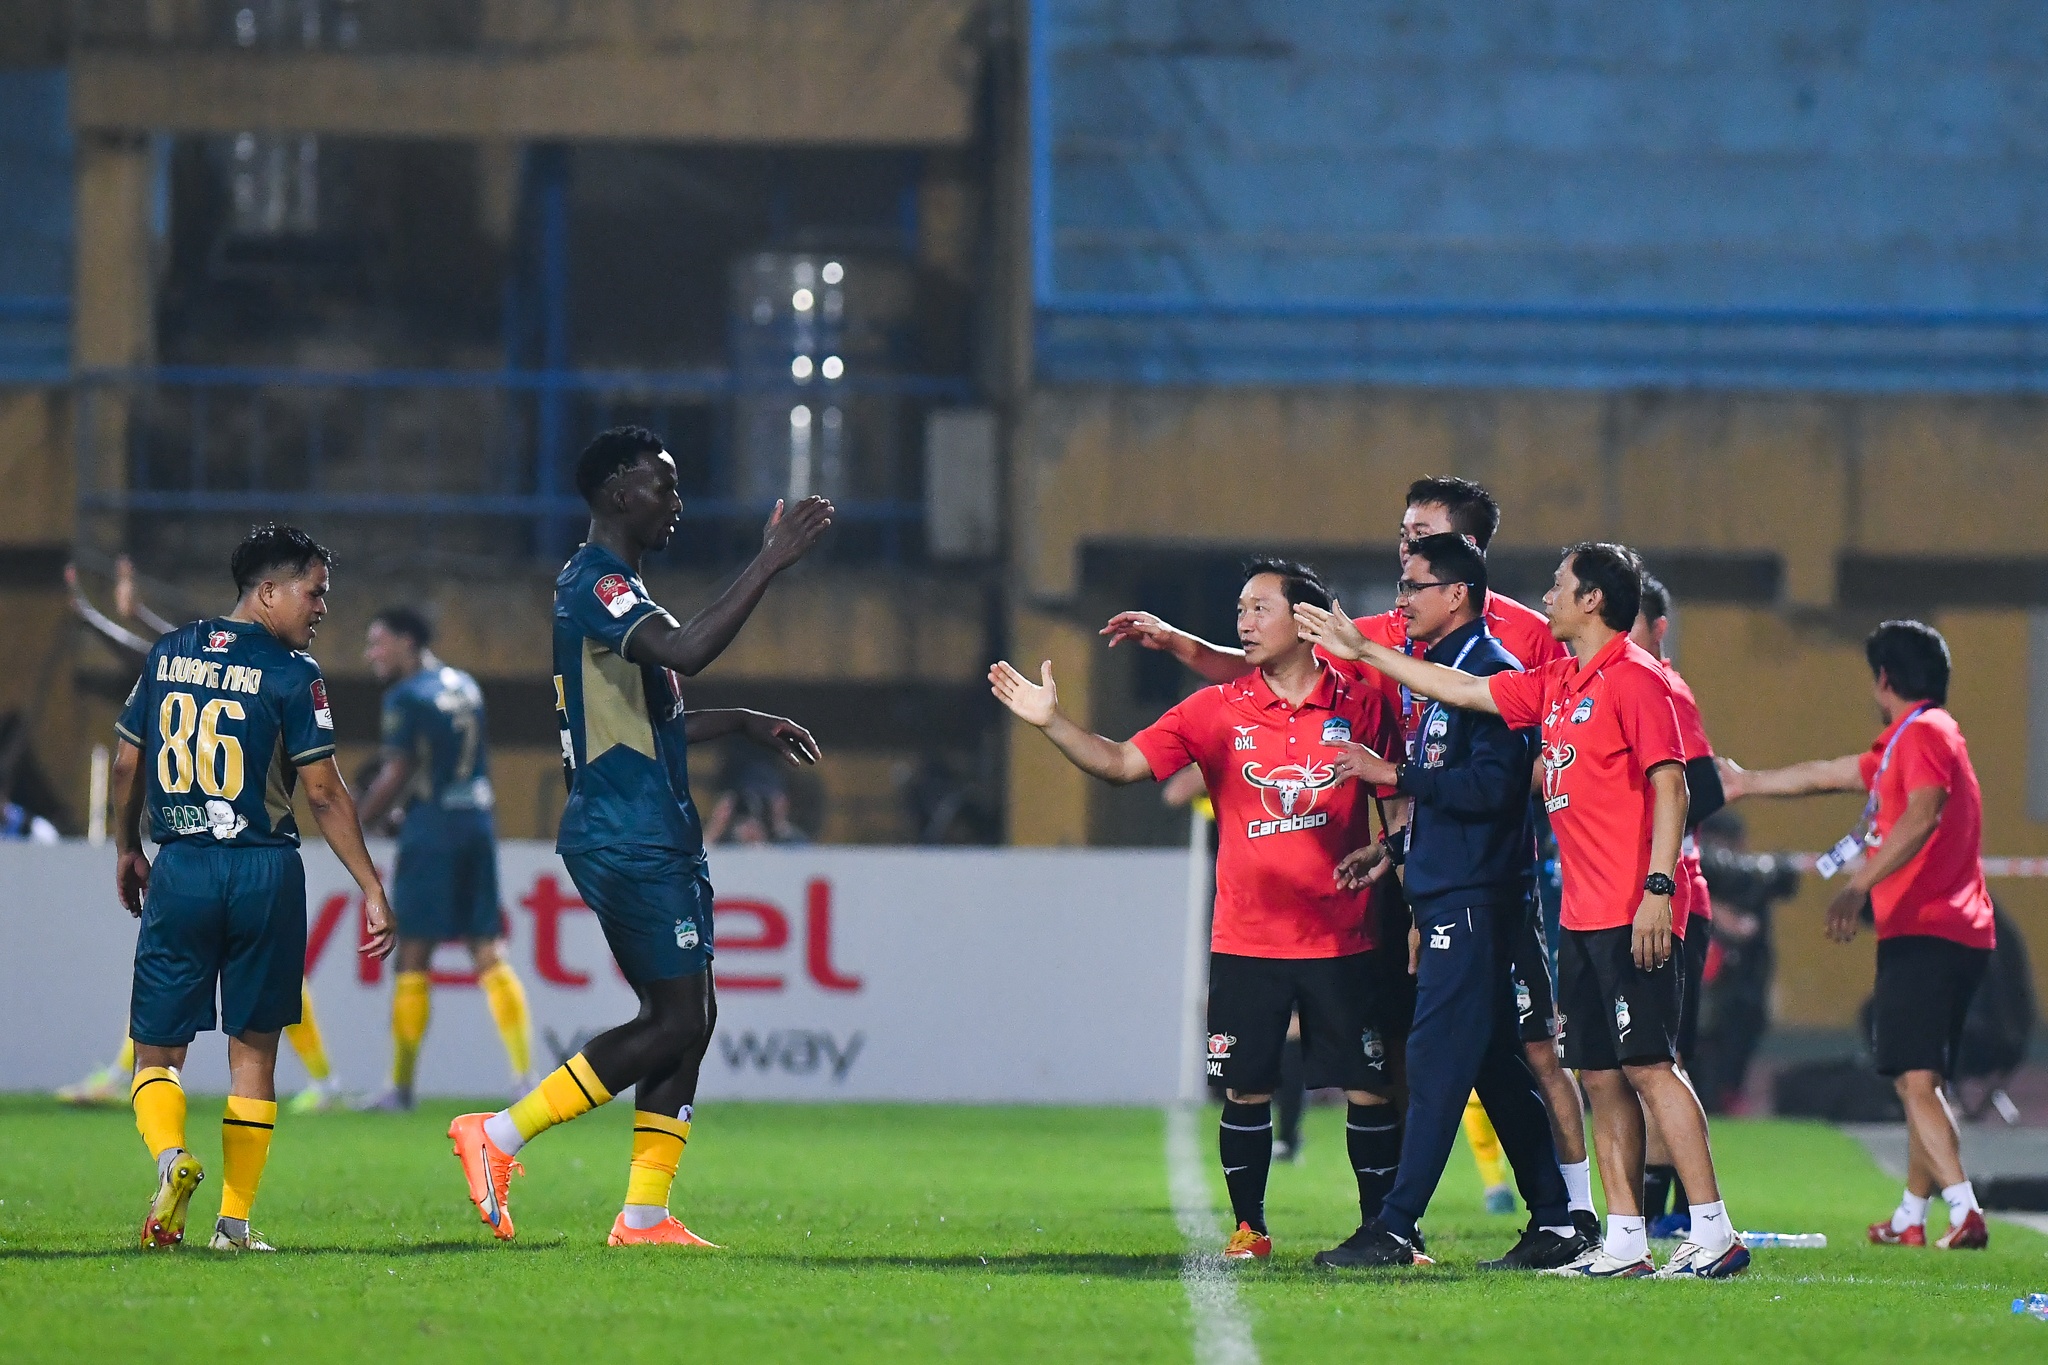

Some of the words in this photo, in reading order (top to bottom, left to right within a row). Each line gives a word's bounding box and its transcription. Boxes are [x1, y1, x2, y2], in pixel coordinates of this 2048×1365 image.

[222, 665, 262, 695] NHO
[158, 691, 246, 801] 86
[162, 805, 207, 829] BAPI
[1247, 812, 1328, 839] Carabao
[717, 1027, 868, 1081] way
